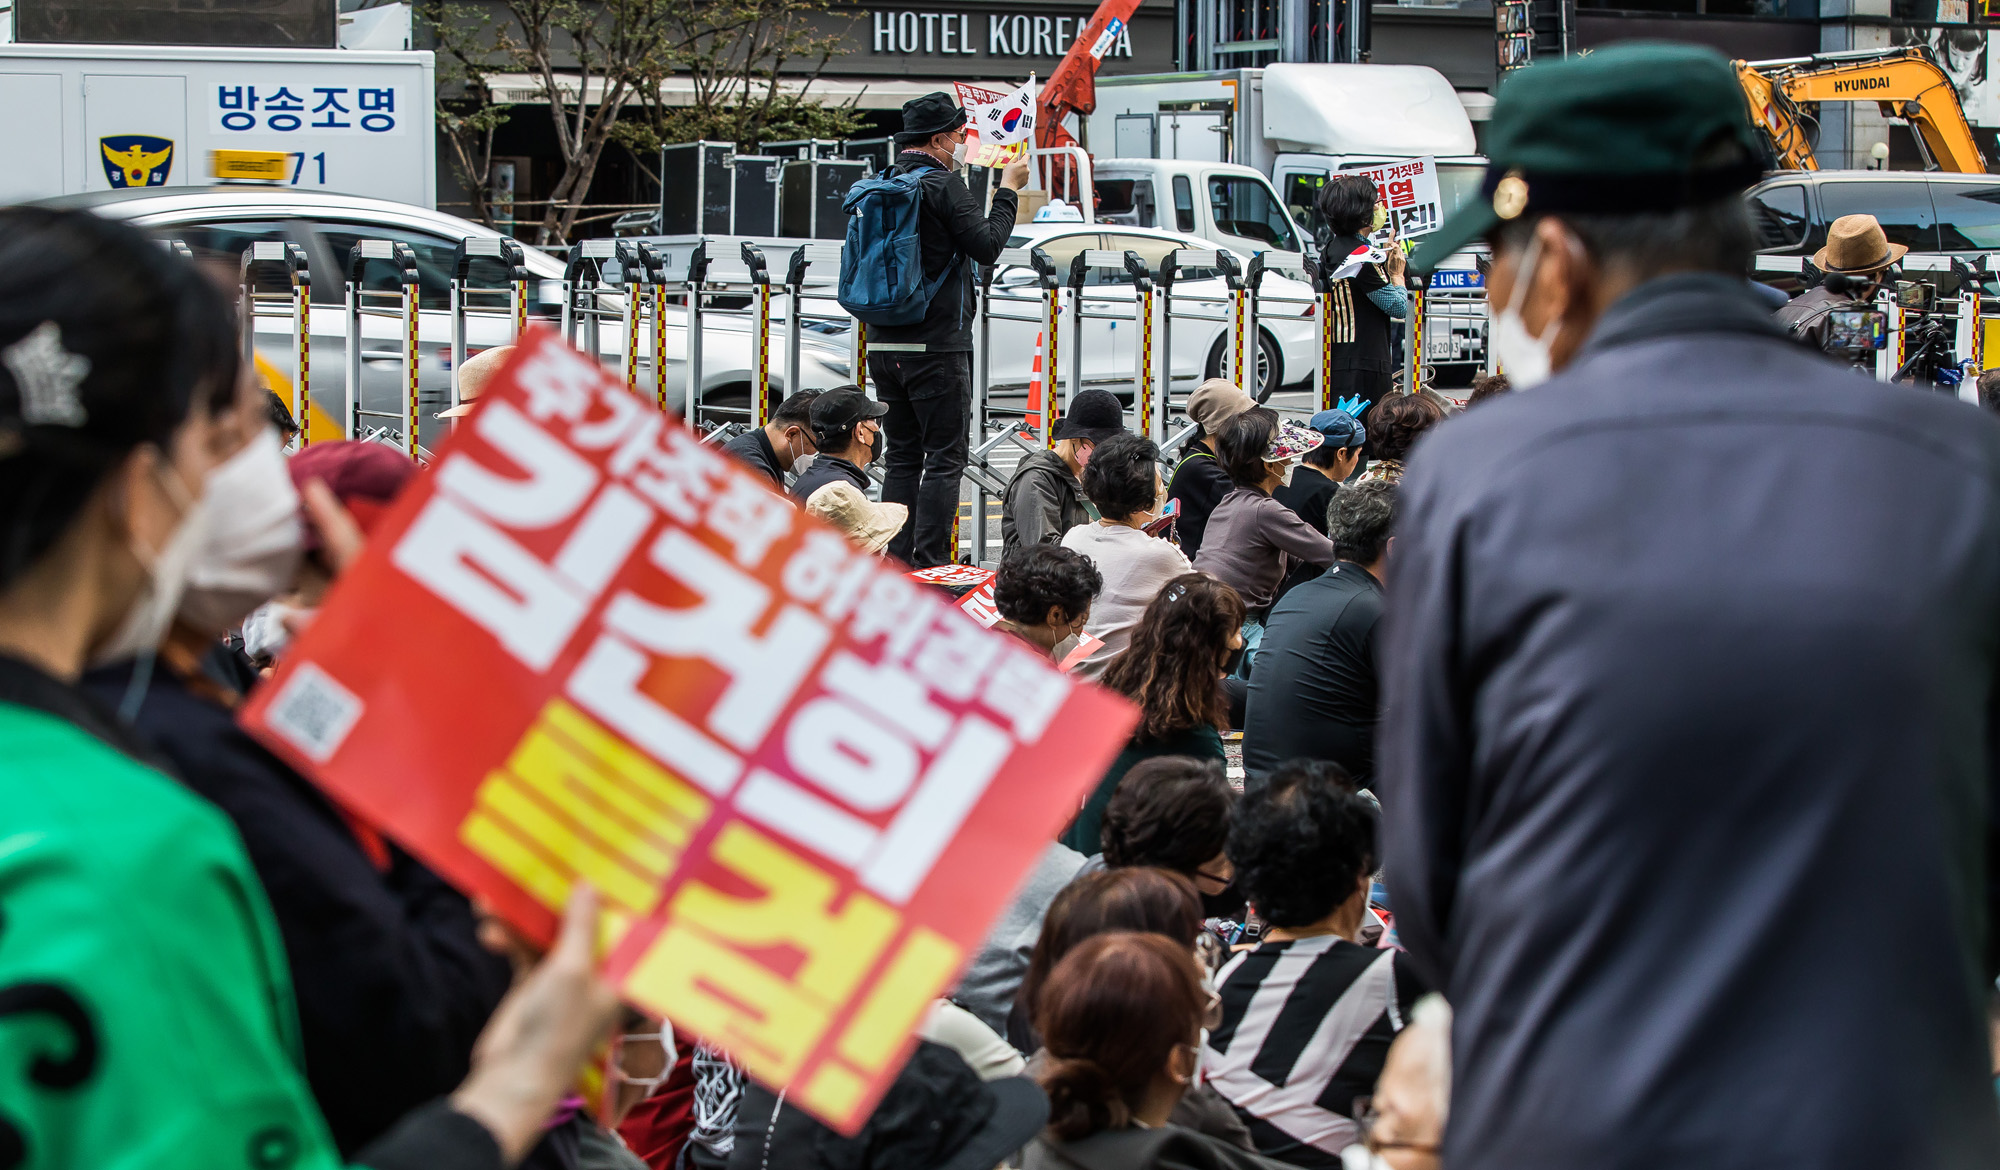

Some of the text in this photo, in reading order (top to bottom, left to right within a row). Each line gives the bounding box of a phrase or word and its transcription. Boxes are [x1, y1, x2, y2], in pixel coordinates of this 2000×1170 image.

[874, 11, 977, 54] HOTEL
[989, 14, 1133, 57] KOREA
[1834, 76, 1890, 92] HYUNDAI
[218, 86, 396, 132] 방송조명
[1388, 161, 1425, 184] 거짓말
[1440, 273, 1464, 286] LINE
[514, 333, 795, 570] 주가조작
[392, 401, 1013, 905] 김건희
[458, 699, 964, 1124] 특검!
